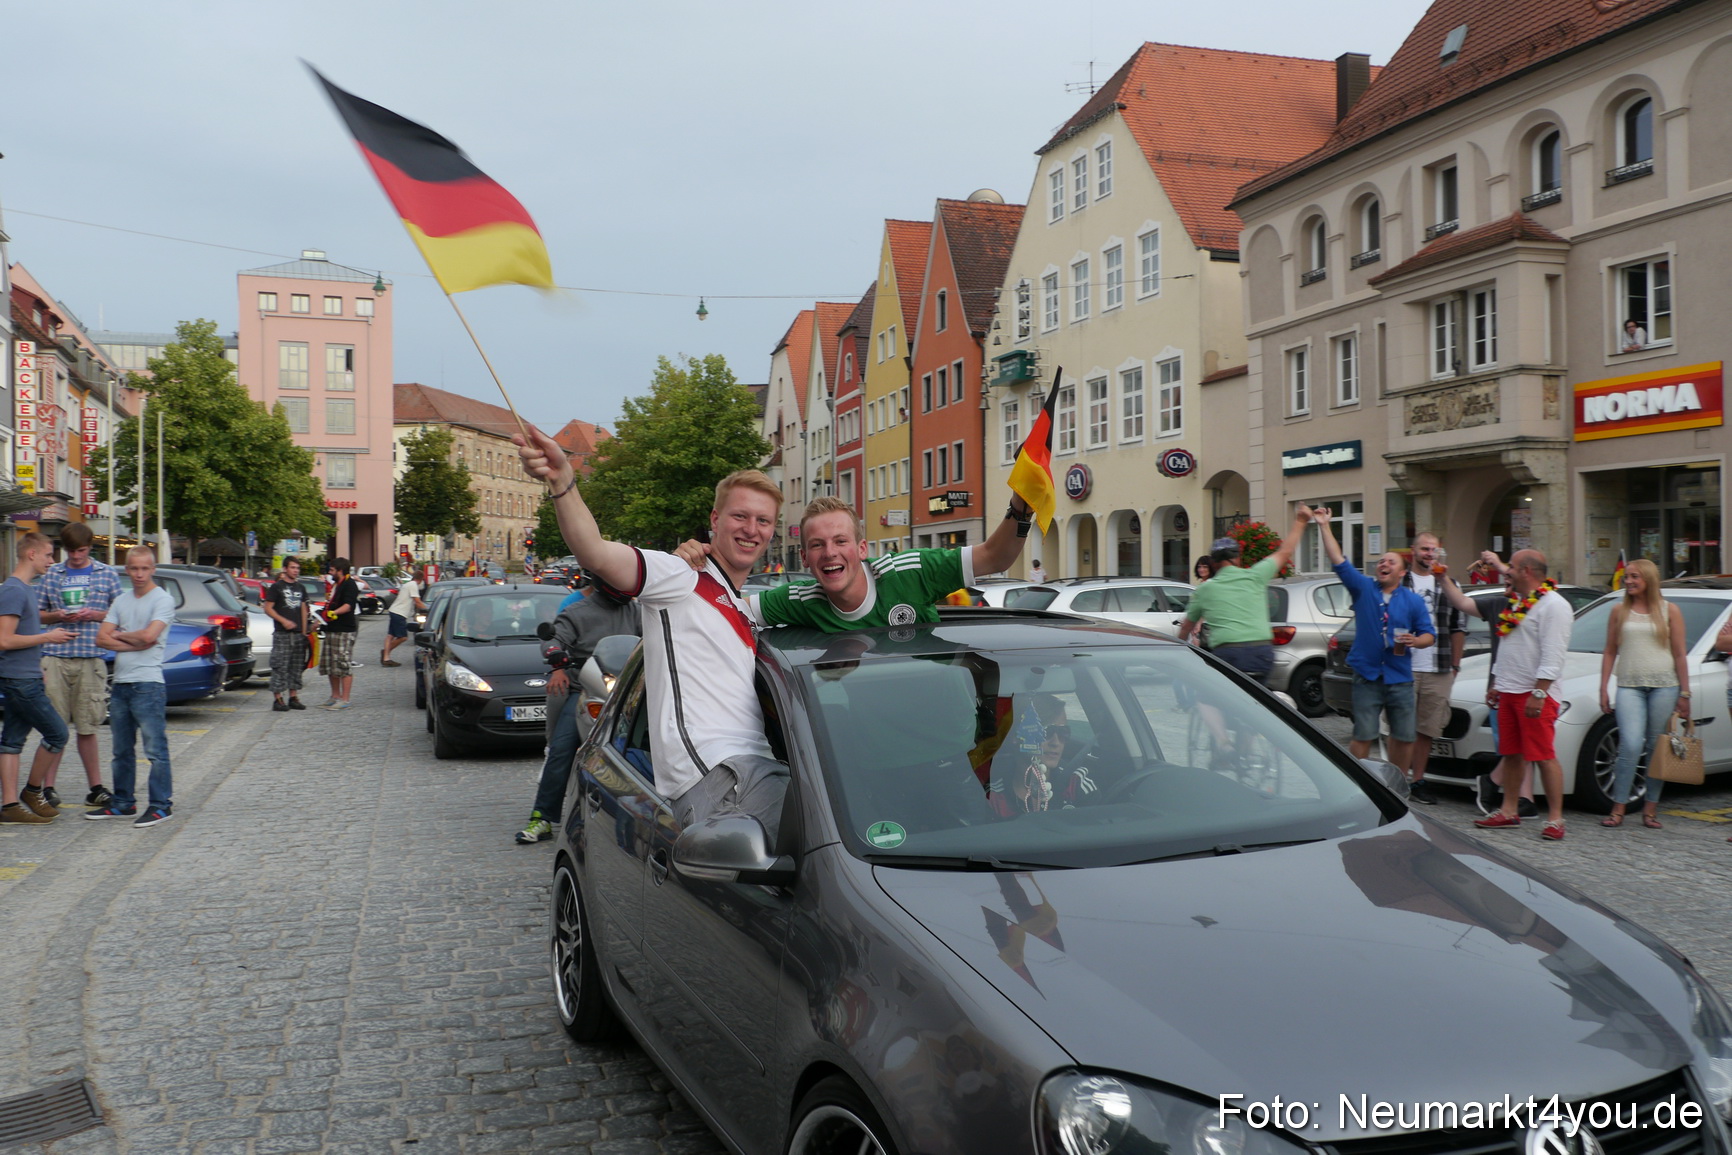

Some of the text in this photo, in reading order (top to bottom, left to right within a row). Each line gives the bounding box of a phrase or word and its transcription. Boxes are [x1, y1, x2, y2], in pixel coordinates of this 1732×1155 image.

[19, 342, 31, 461] BÄCKEREI
[1583, 383, 1702, 423] NORMA
[84, 408, 98, 514] METZGREI
[512, 707, 527, 718] NM
[879, 822, 891, 834] 4
